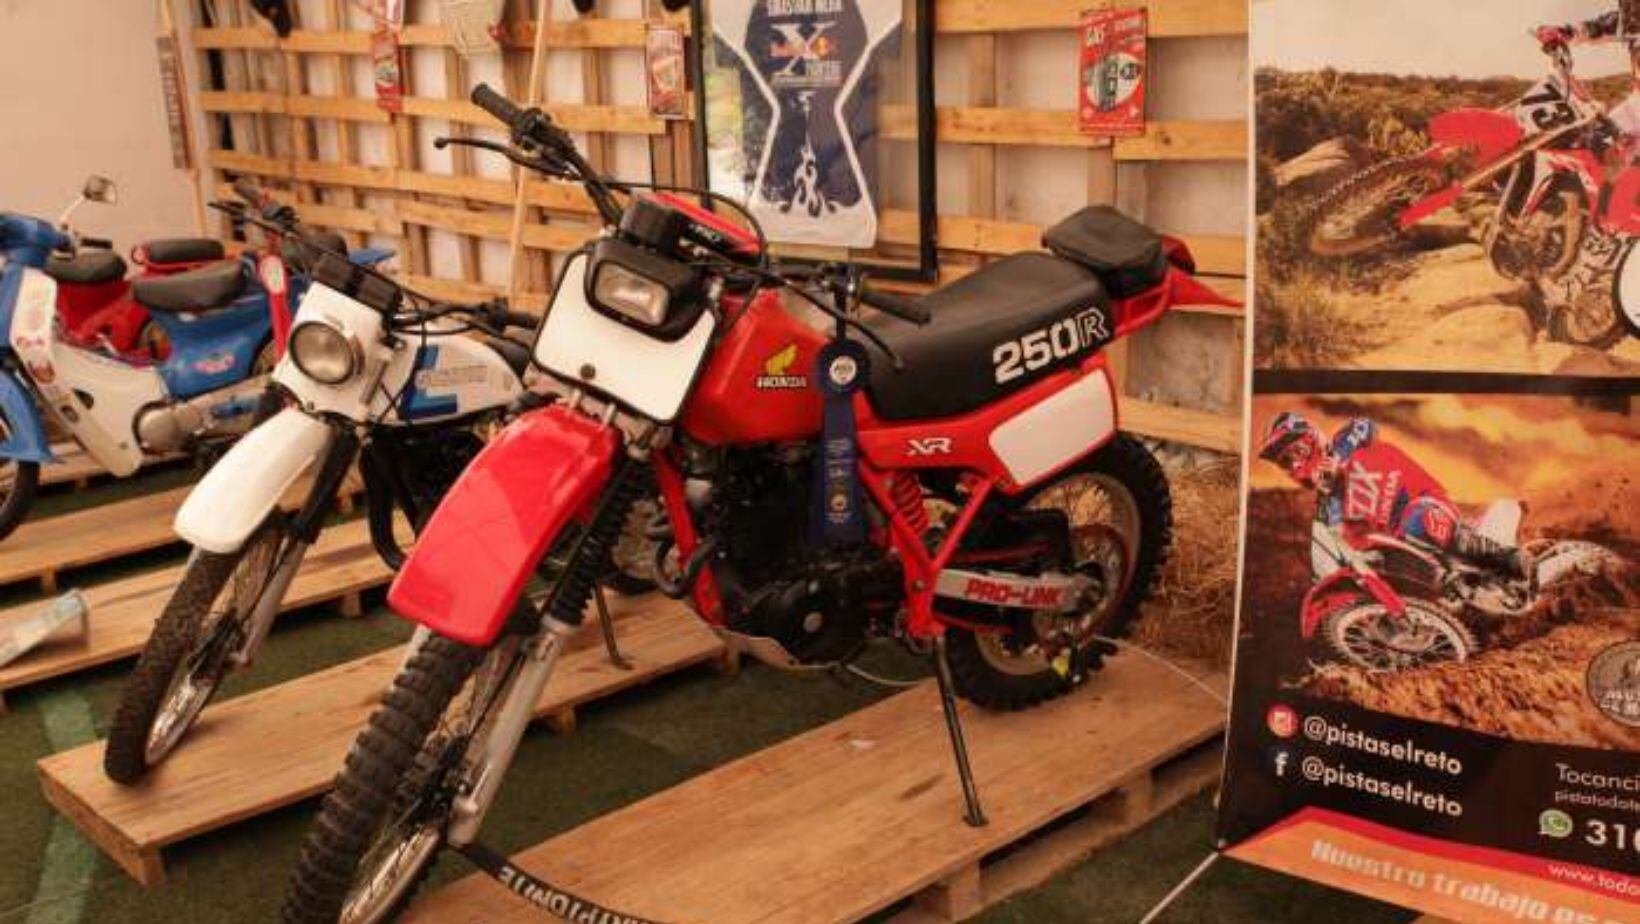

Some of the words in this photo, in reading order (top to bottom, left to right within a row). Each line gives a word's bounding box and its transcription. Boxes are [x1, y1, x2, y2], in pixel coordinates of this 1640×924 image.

[993, 307, 1110, 385] 250R
[756, 376, 808, 388] HONDA
[906, 437, 951, 456] XR
[965, 577, 1063, 605] PRO-LINK
[1303, 715, 1463, 776] @pistaselreto
[1301, 756, 1464, 818] @pistaselreto
[1433, 872, 1549, 919] trabajo
